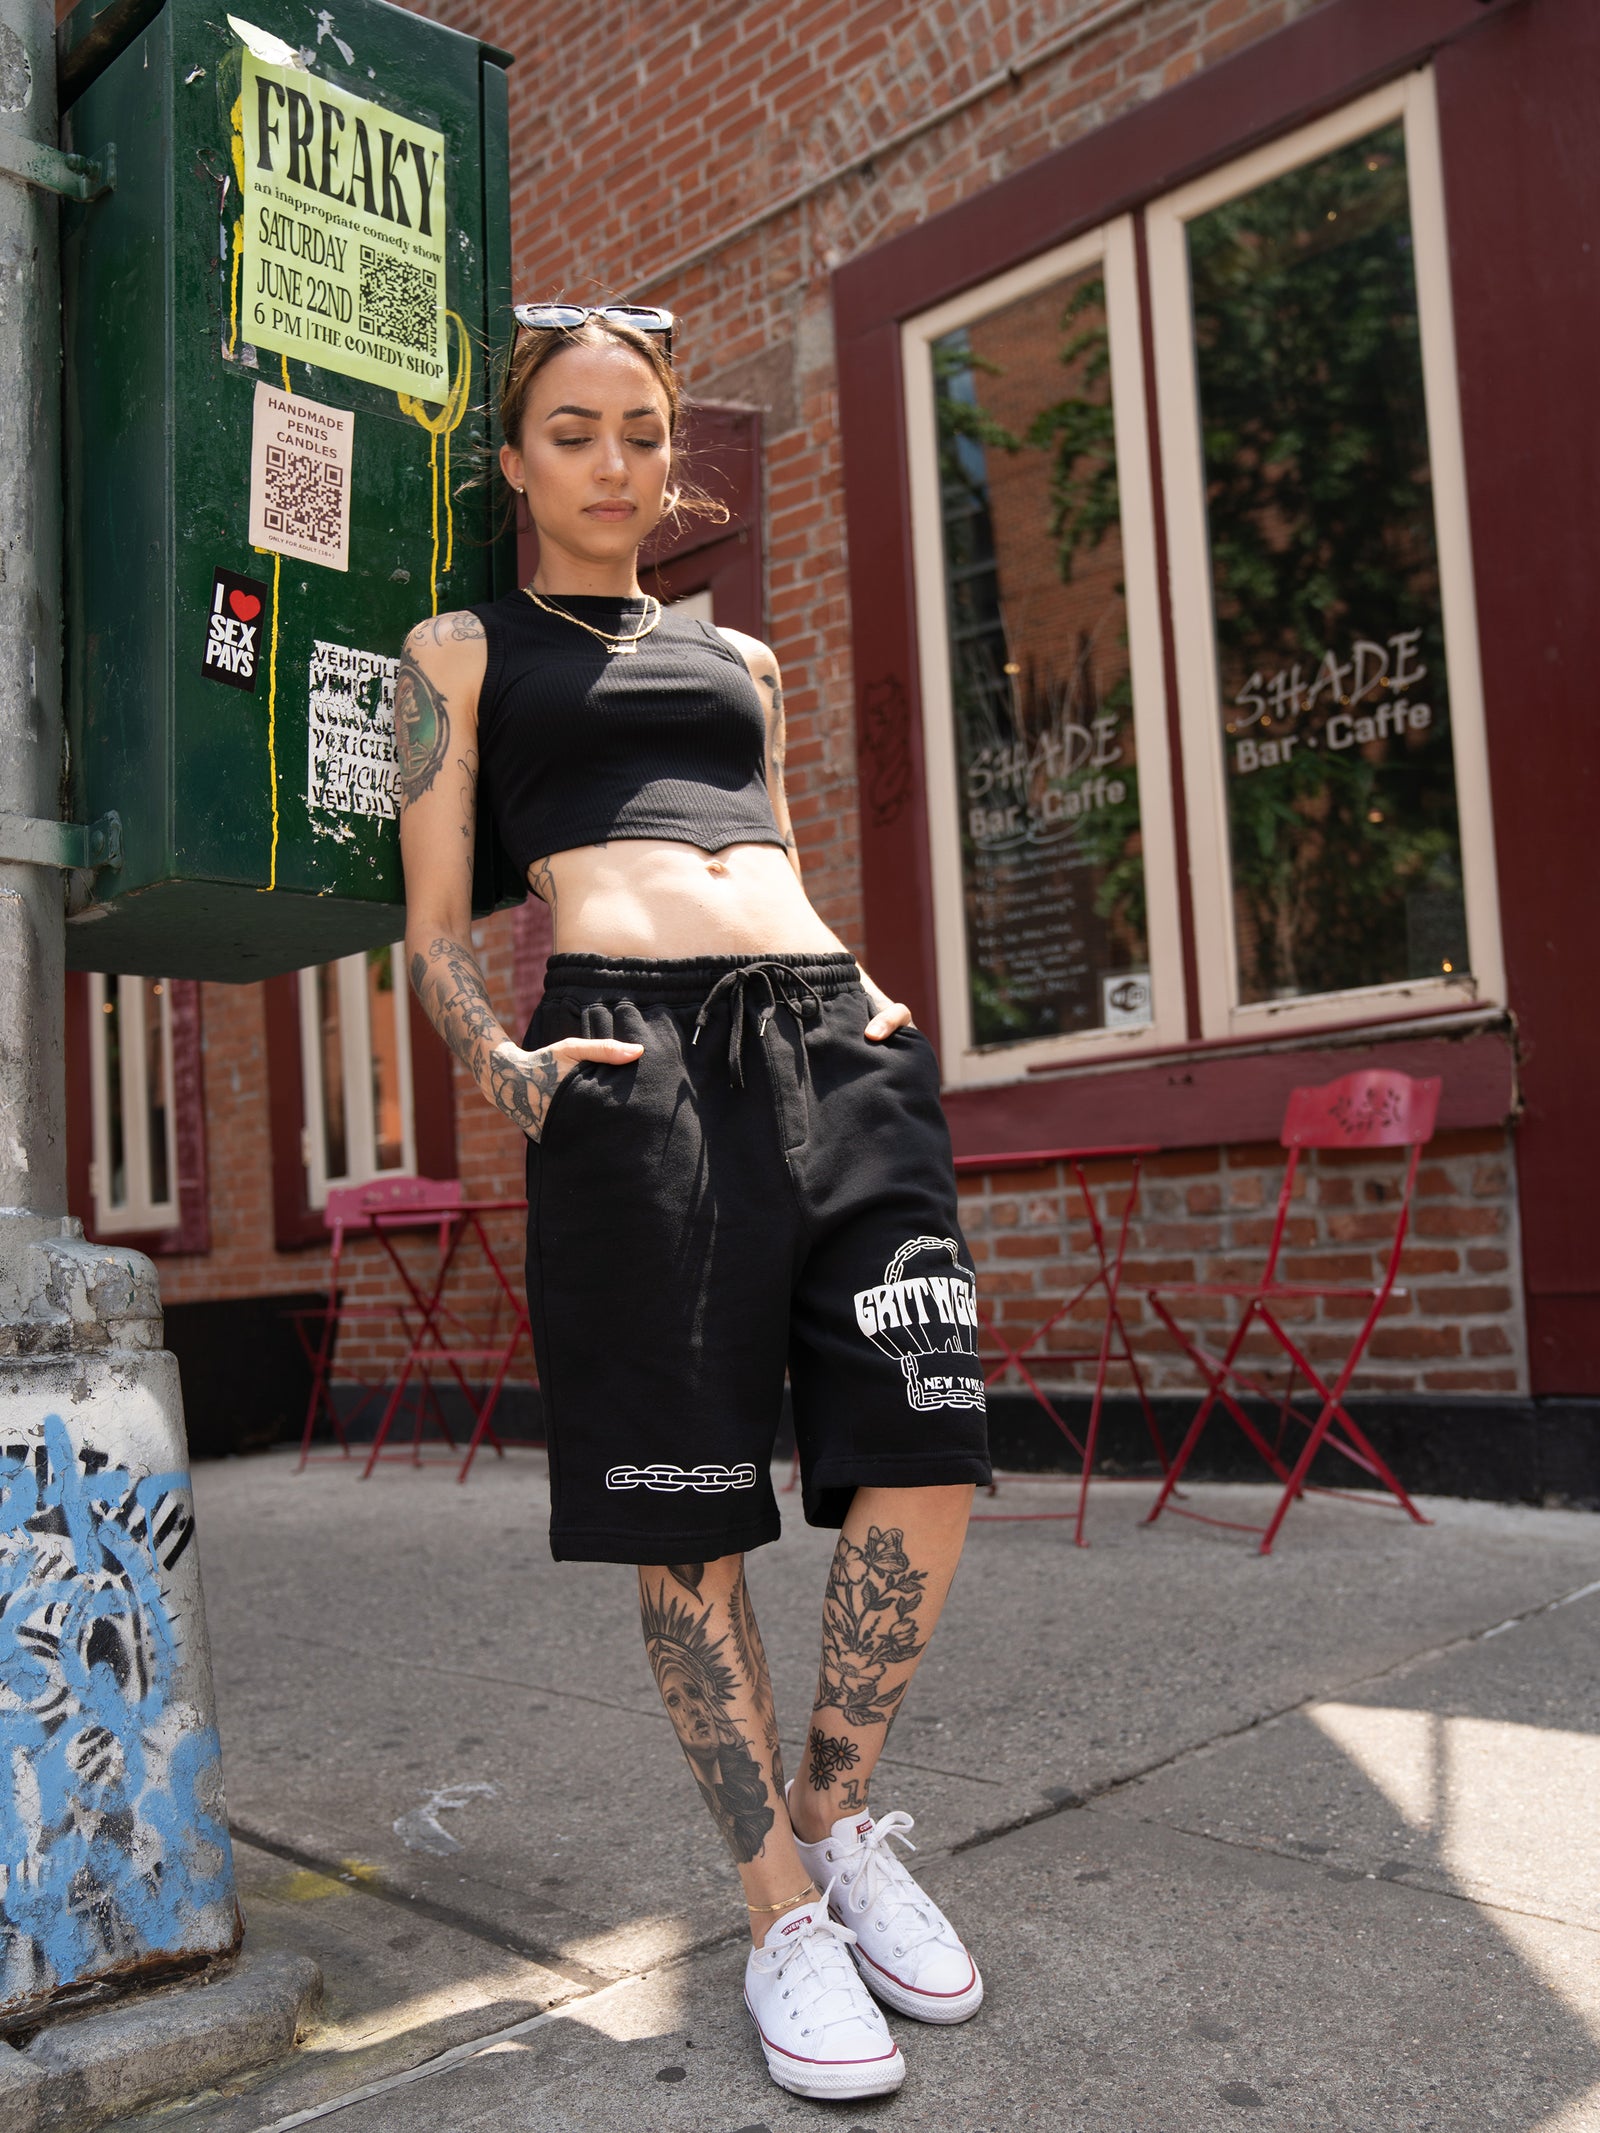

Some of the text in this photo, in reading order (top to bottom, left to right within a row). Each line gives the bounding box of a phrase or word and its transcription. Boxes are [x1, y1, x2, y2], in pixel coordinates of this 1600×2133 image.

[255, 75, 440, 237] FREAKY
[254, 183, 442, 264] an inappropriate comedy show
[259, 206, 348, 273] SATURDAY
[257, 258, 353, 324] JUNE 22ND
[254, 302, 444, 379] 6 PM THE COMEDY SHOP
[268, 397, 344, 431] HANDMADE
[276, 431, 337, 459] CANDLES
[287, 419, 328, 441] PENIS
[268, 535, 284, 543] ONLY
[285, 539, 298, 547] FOR
[298, 544, 317, 552] ADULT
[214, 582, 225, 614] I
[205, 638, 254, 678] PAYS
[209, 614, 257, 653] SEX
[1235, 626, 1427, 727] SHADE
[968, 714, 1122, 798] SHADE
[1236, 698, 1431, 774] Bar Caffe
[968, 805, 1021, 839] Bar
[1041, 775, 1126, 822] Caffe
[923, 1376, 953, 1391] NEW
